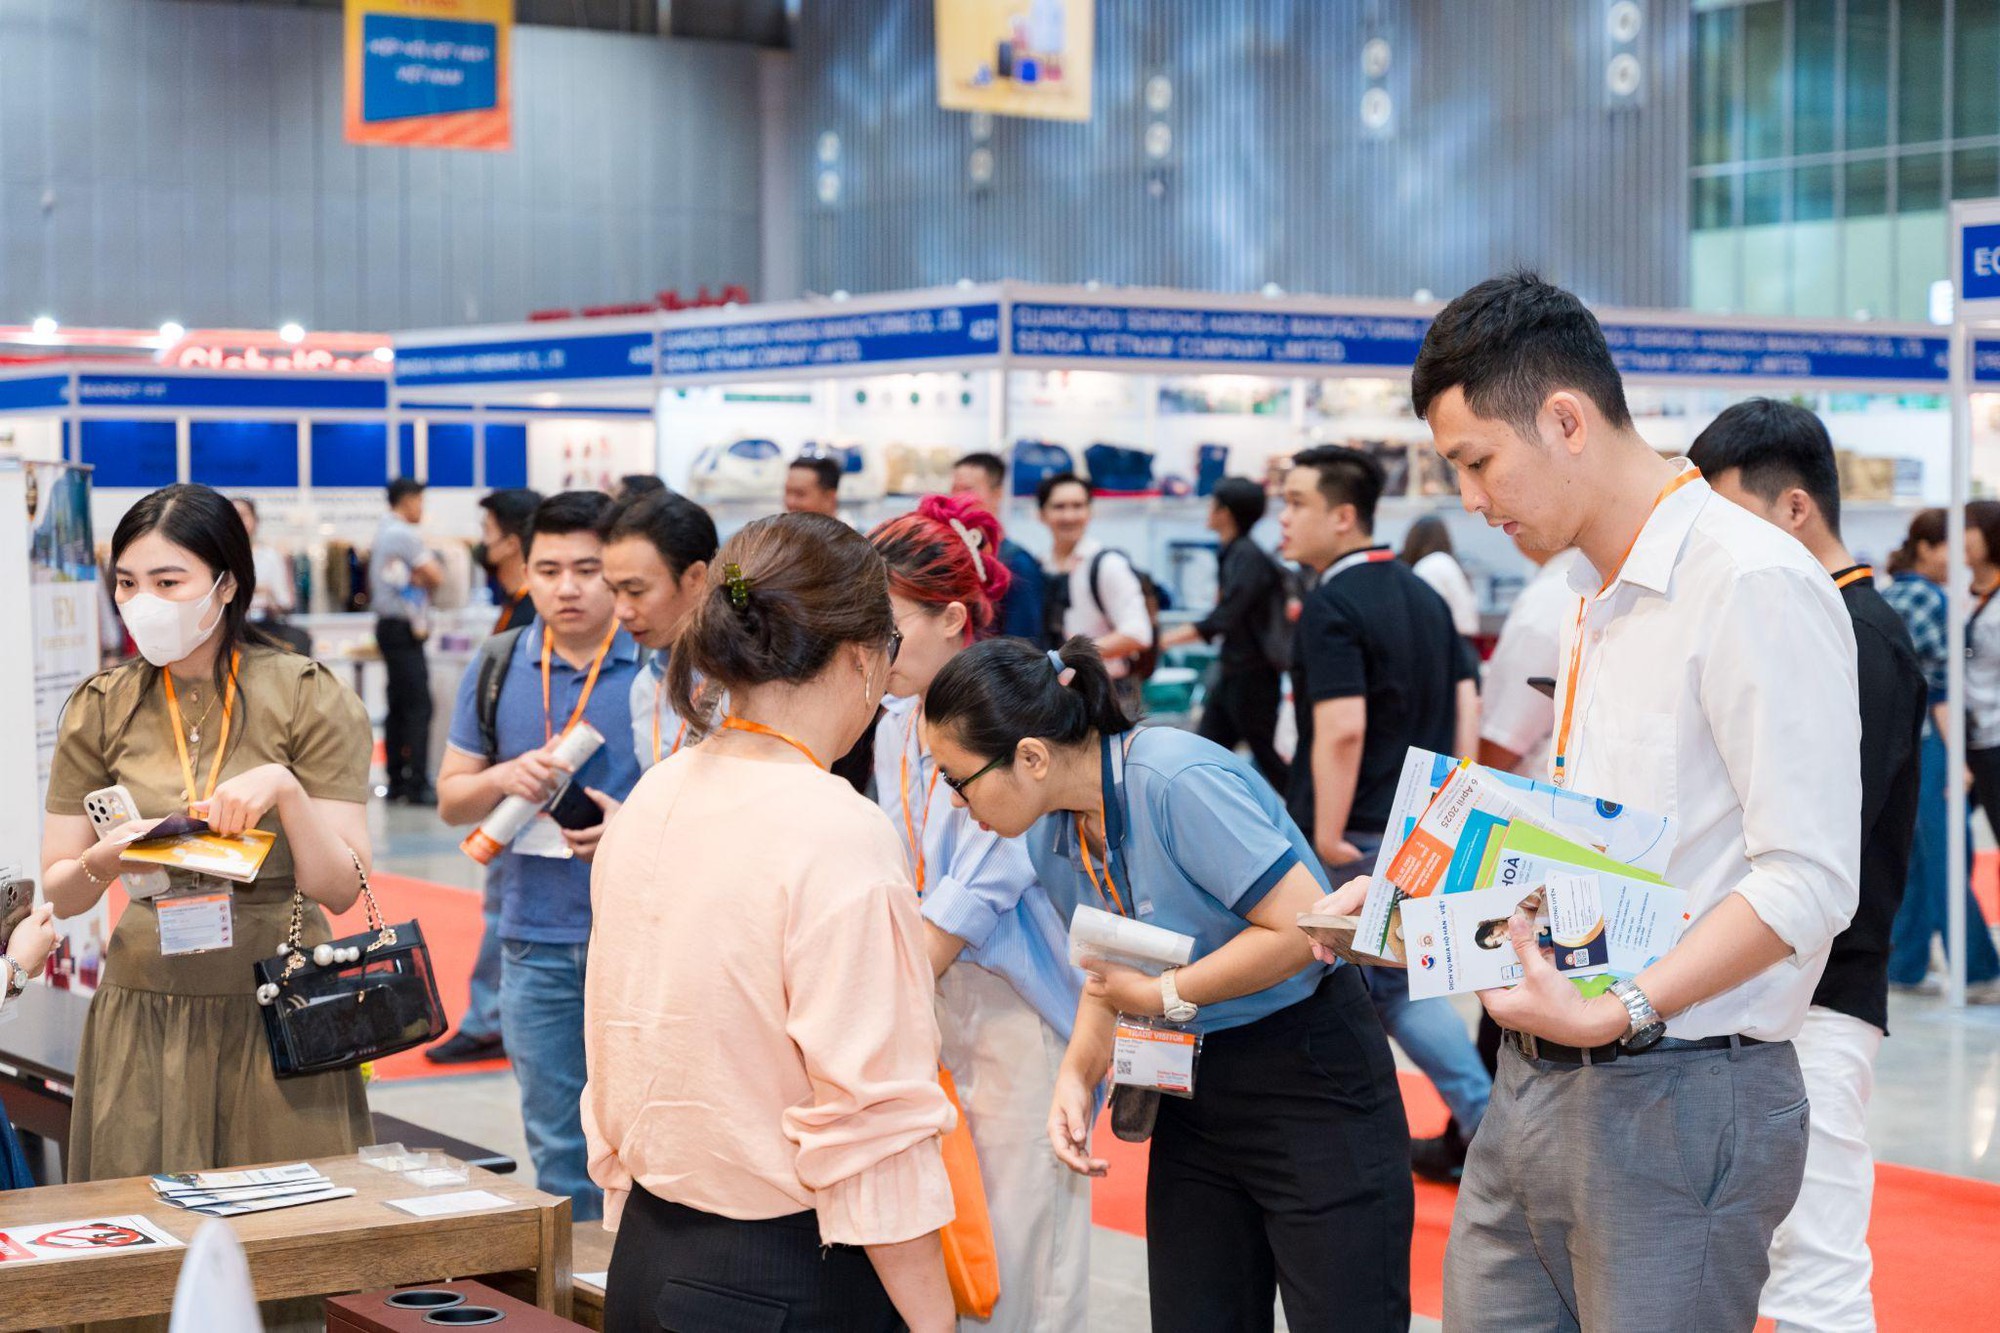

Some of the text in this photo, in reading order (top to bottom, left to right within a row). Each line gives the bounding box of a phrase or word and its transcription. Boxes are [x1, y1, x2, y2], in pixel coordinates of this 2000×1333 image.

[1458, 786, 1474, 807] April
[1440, 806, 1460, 829] 2025
[1153, 1031, 1185, 1043] VISITOR
